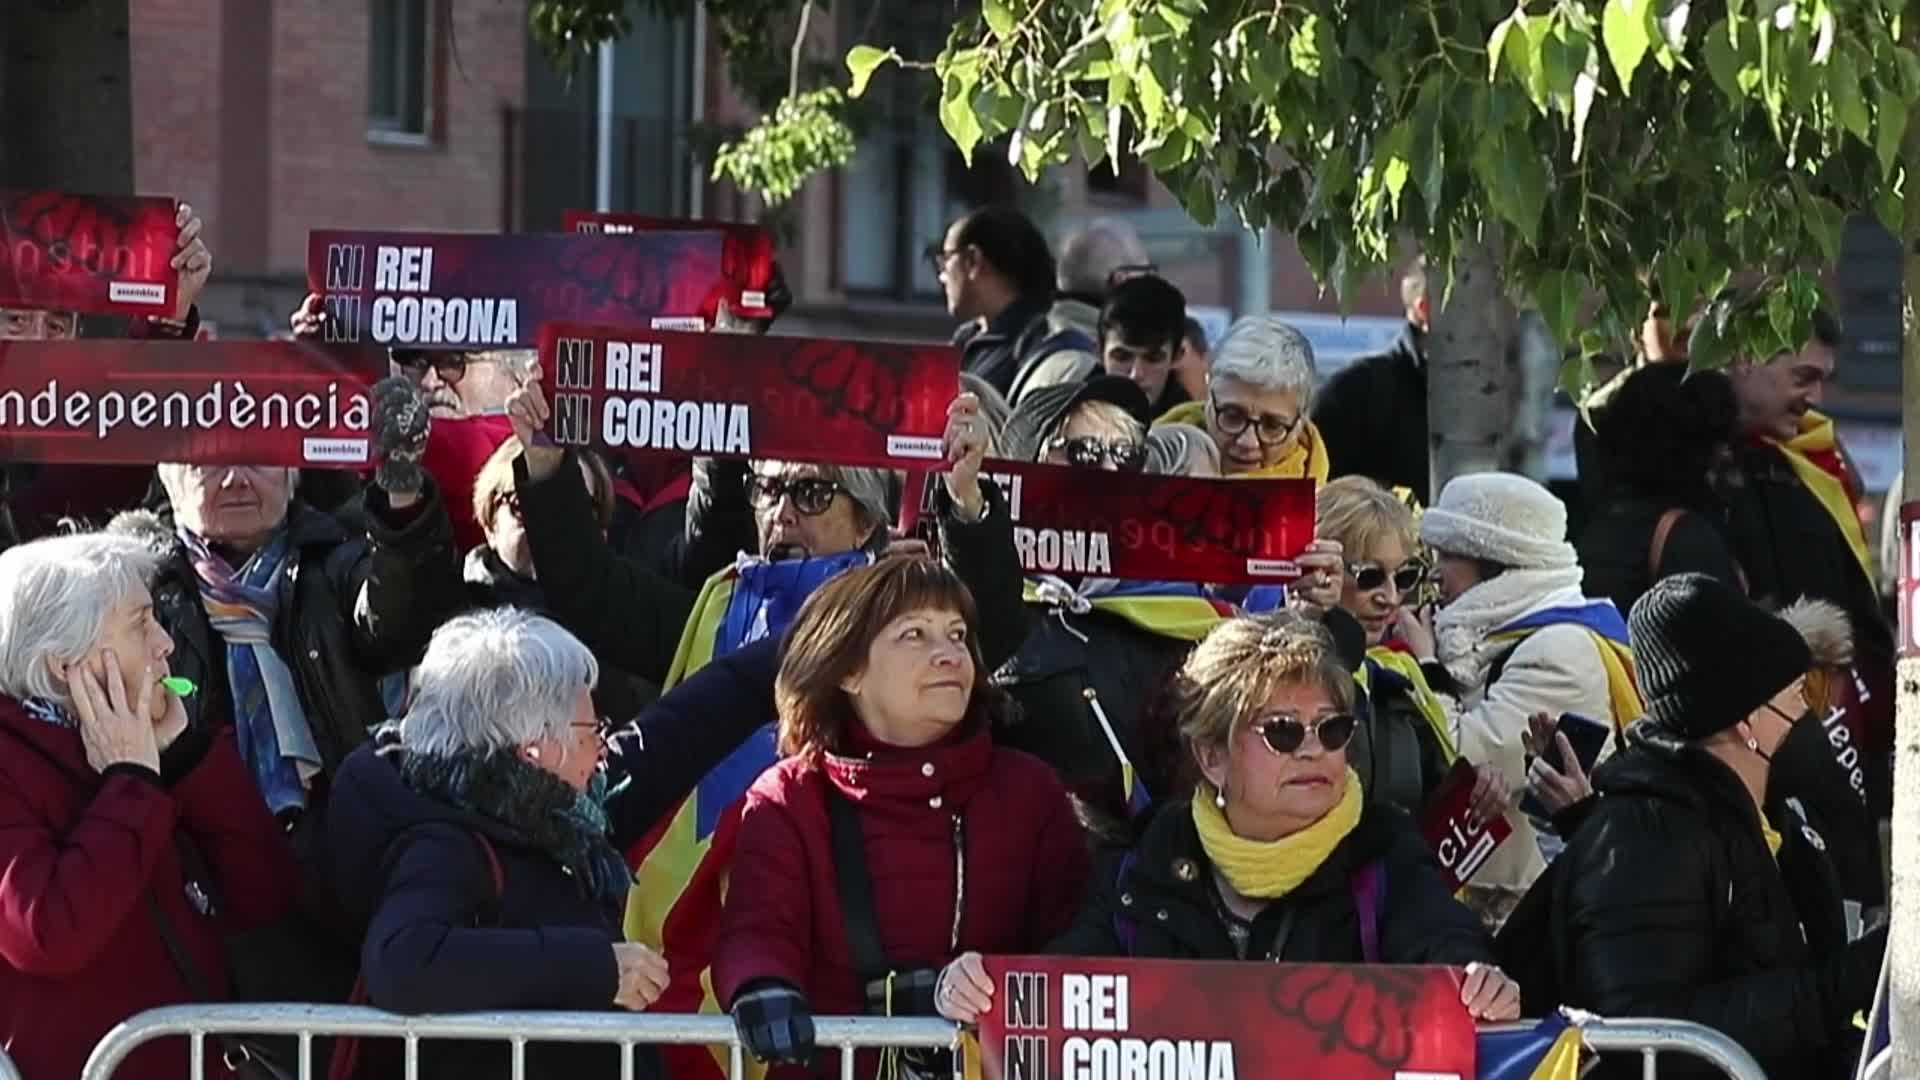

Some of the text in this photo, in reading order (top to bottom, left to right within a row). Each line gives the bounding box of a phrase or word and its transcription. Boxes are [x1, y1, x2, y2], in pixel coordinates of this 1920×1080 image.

[326, 244, 433, 292] NI REI
[324, 295, 517, 344] NI CORONA
[555, 337, 663, 393] NI REI
[0, 380, 370, 438] ndependència
[554, 393, 592, 445] NI
[602, 397, 750, 454] CORONA
[1013, 527, 1111, 574] RONA
[1005, 972, 1129, 1031] NI REI
[1005, 1035, 1235, 1080] NI CORONA
